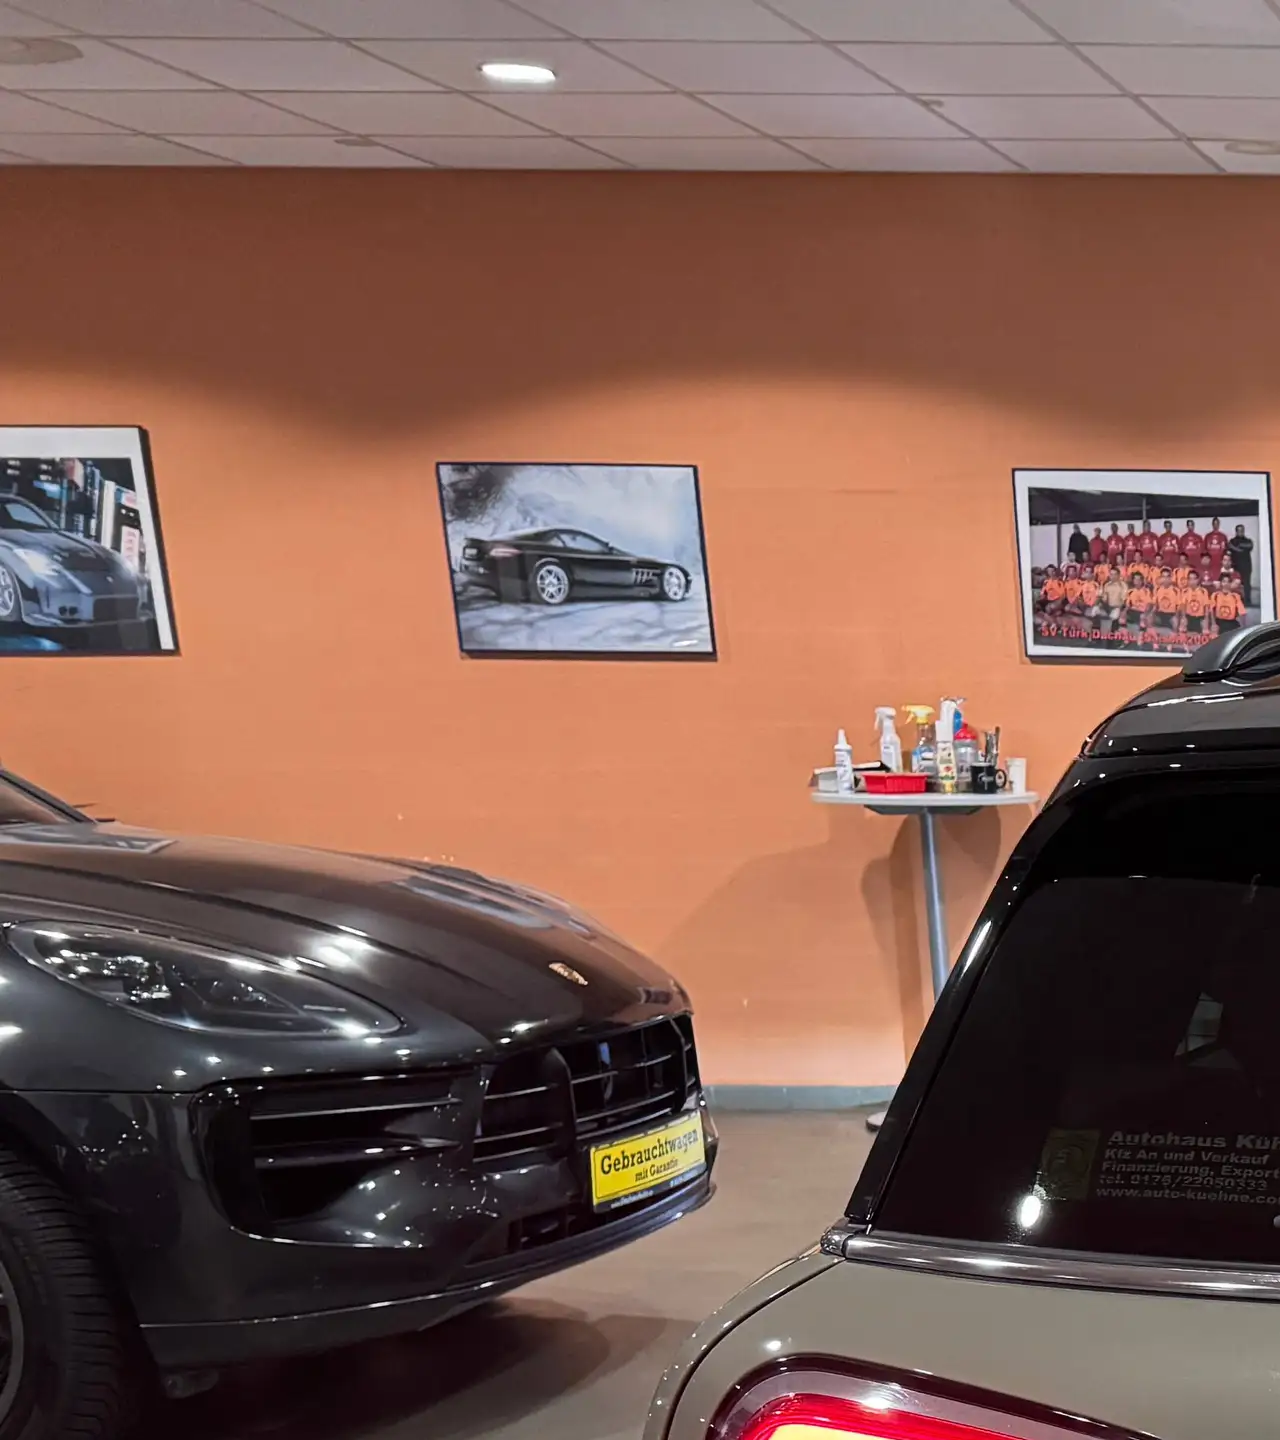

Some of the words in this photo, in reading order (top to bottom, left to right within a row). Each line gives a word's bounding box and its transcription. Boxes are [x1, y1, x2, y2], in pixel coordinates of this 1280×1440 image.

[1108, 1130, 1227, 1149] Autohaus
[600, 1129, 698, 1175] Gebrauchtwagen
[1136, 1149, 1158, 1161] An
[1164, 1150, 1194, 1162] und
[1202, 1152, 1270, 1165] Verkauf
[635, 1169, 649, 1182] mit
[1221, 1165, 1280, 1180] Export
